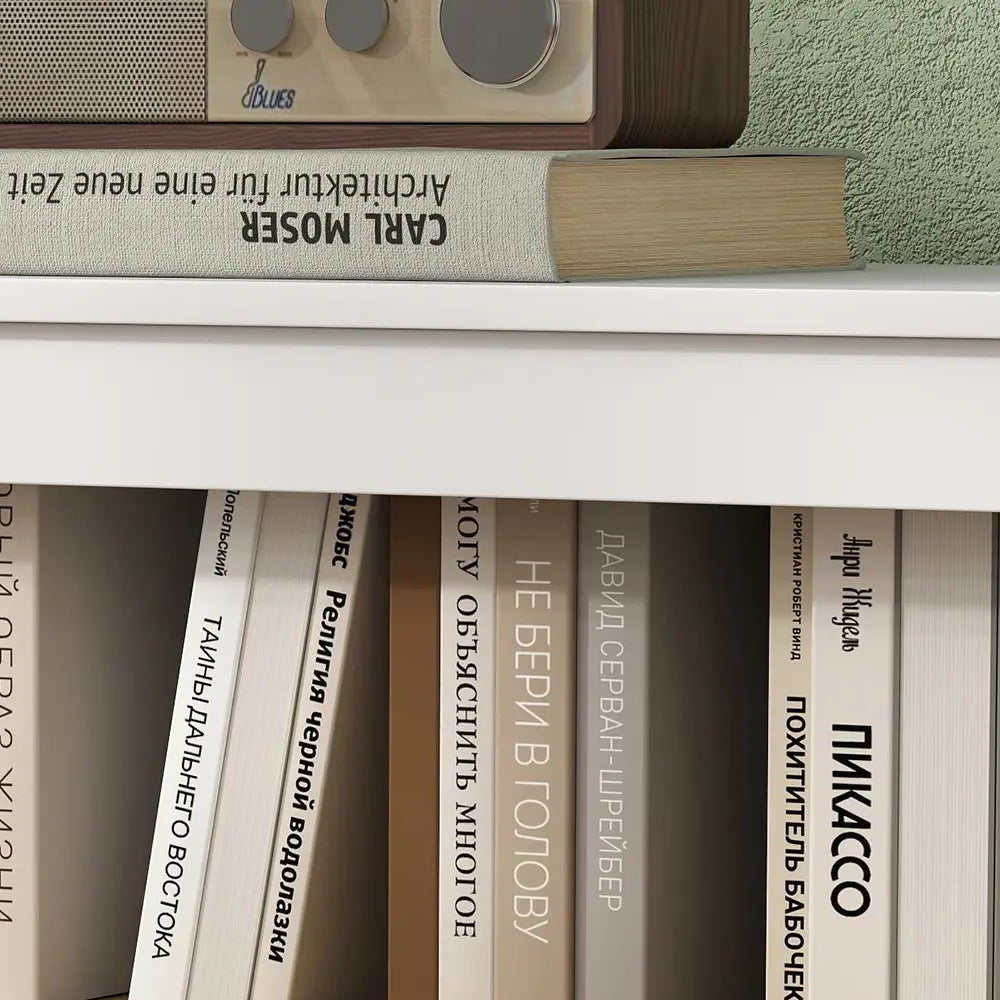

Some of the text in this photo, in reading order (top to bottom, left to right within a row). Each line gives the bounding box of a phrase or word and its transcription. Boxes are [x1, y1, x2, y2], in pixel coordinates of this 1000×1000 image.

[7, 170, 451, 209] Architektur für eine neue Zeit
[239, 210, 448, 246] CARL MOSER
[789, 513, 803, 661] КРИСТИАН РОБЕРТ ВИНД
[829, 533, 873, 653] Анри Жидель
[455, 594, 479, 791] ОБЪЯСНИТЬ
[513, 560, 551, 944] НЕ БЕРИ В ГОЛОВУ
[594, 529, 628, 912] ДАВИД СЕРВАН-ШРЕЙБЕР
[170, 706, 207, 838] ДАЛЬНЕГО
[268, 590, 347, 964] Религия черной водолазки
[784, 696, 807, 872] ПОХИТИТЕЛЬ
[830, 723, 873, 918] ПИКАССО
[151, 844, 187, 960] ВОСТОКА
[454, 801, 477, 938] МНОГОЕ
